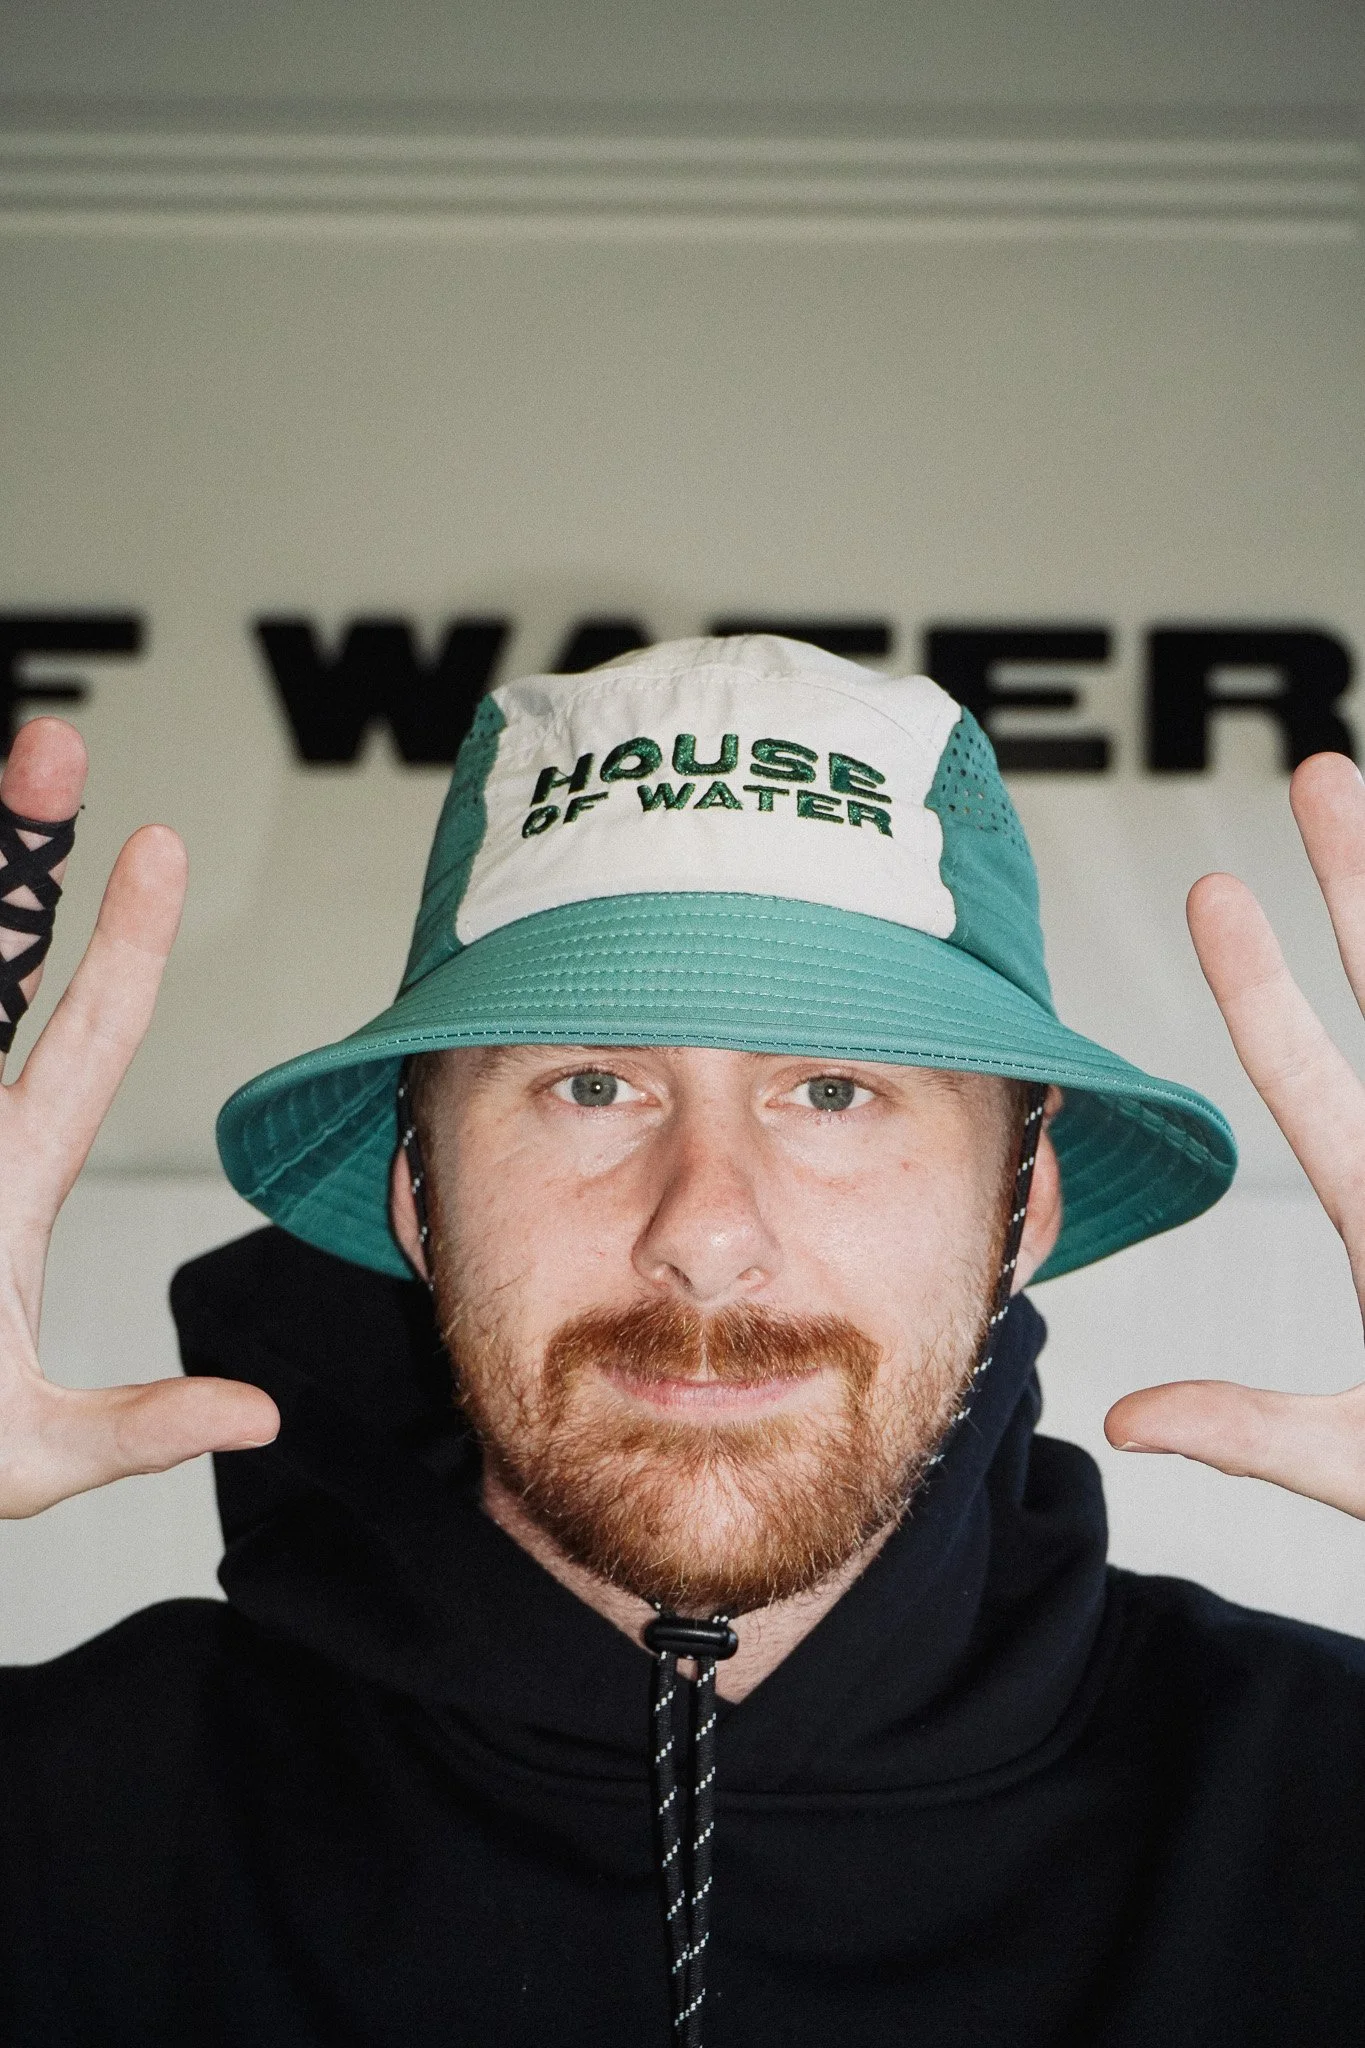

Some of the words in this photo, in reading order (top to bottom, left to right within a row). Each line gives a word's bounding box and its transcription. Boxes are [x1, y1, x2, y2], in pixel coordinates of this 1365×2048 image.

[254, 614, 1363, 777] WER
[530, 733, 893, 807] HOUSE
[521, 791, 610, 839] OF
[636, 780, 894, 839] WATER
